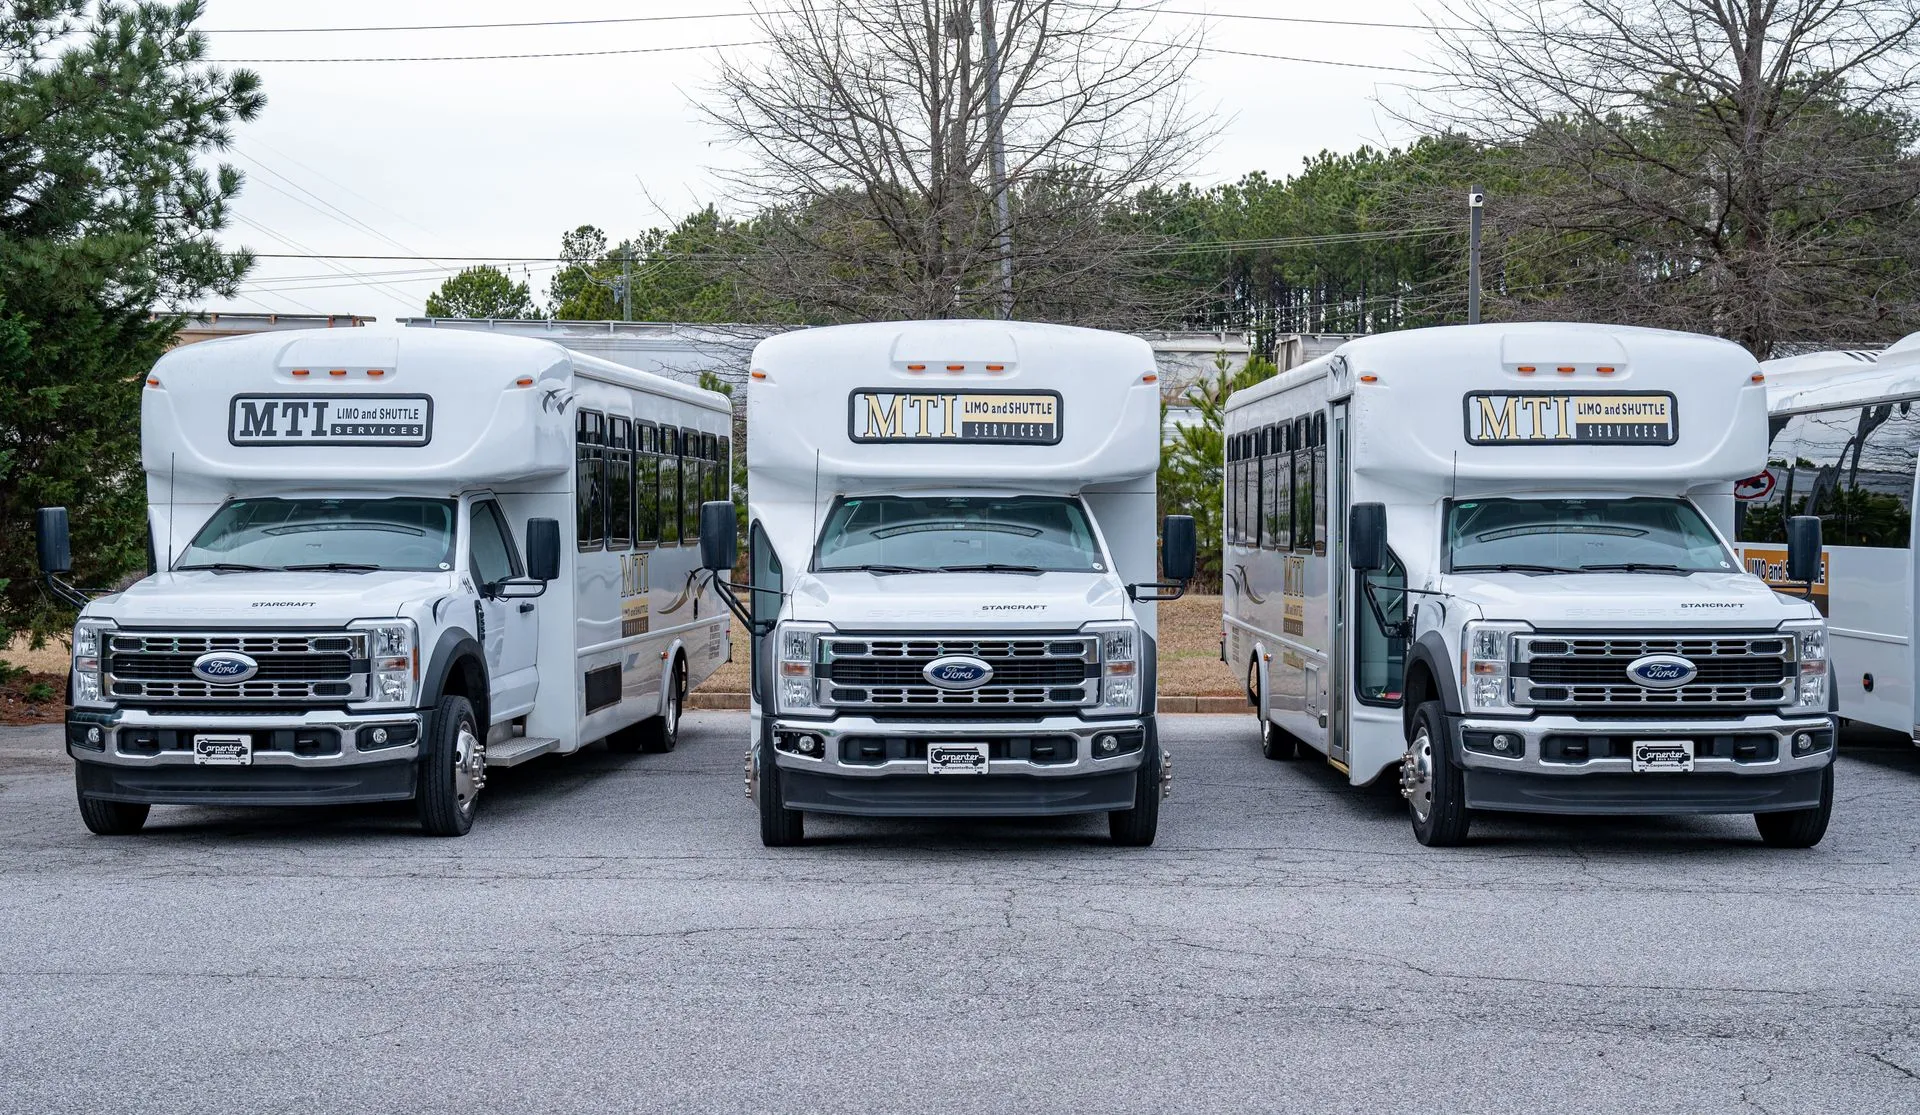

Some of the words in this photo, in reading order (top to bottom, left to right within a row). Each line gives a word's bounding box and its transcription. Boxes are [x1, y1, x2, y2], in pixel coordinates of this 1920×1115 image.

[337, 408, 359, 419] LIMO
[361, 408, 377, 419] and
[379, 408, 419, 419] SHUTTLE
[965, 401, 989, 414] LIMO
[991, 402, 1008, 414] and
[1009, 402, 1052, 415] SHUTTLE
[1578, 403, 1601, 415] LIMO
[1605, 404, 1620, 415] and
[1622, 403, 1665, 415] SHUTTLE
[240, 402, 328, 436] MTI
[864, 394, 957, 438] MTI
[1477, 397, 1570, 439] MTI
[335, 426, 419, 434] SERVICES
[974, 423, 1043, 437] SERVICES
[1589, 425, 1657, 438] SERVICES
[620, 552, 649, 597] MTI
[1283, 555, 1305, 597] MTI
[1768, 559, 1783, 582] and
[208, 660, 239, 674] Ford
[942, 665, 974, 679] Ford
[1647, 664, 1680, 678] Ford
[198, 740, 242, 754] Carpenter
[1638, 746, 1685, 760] Carpenter
[932, 748, 979, 763] Carpenter
